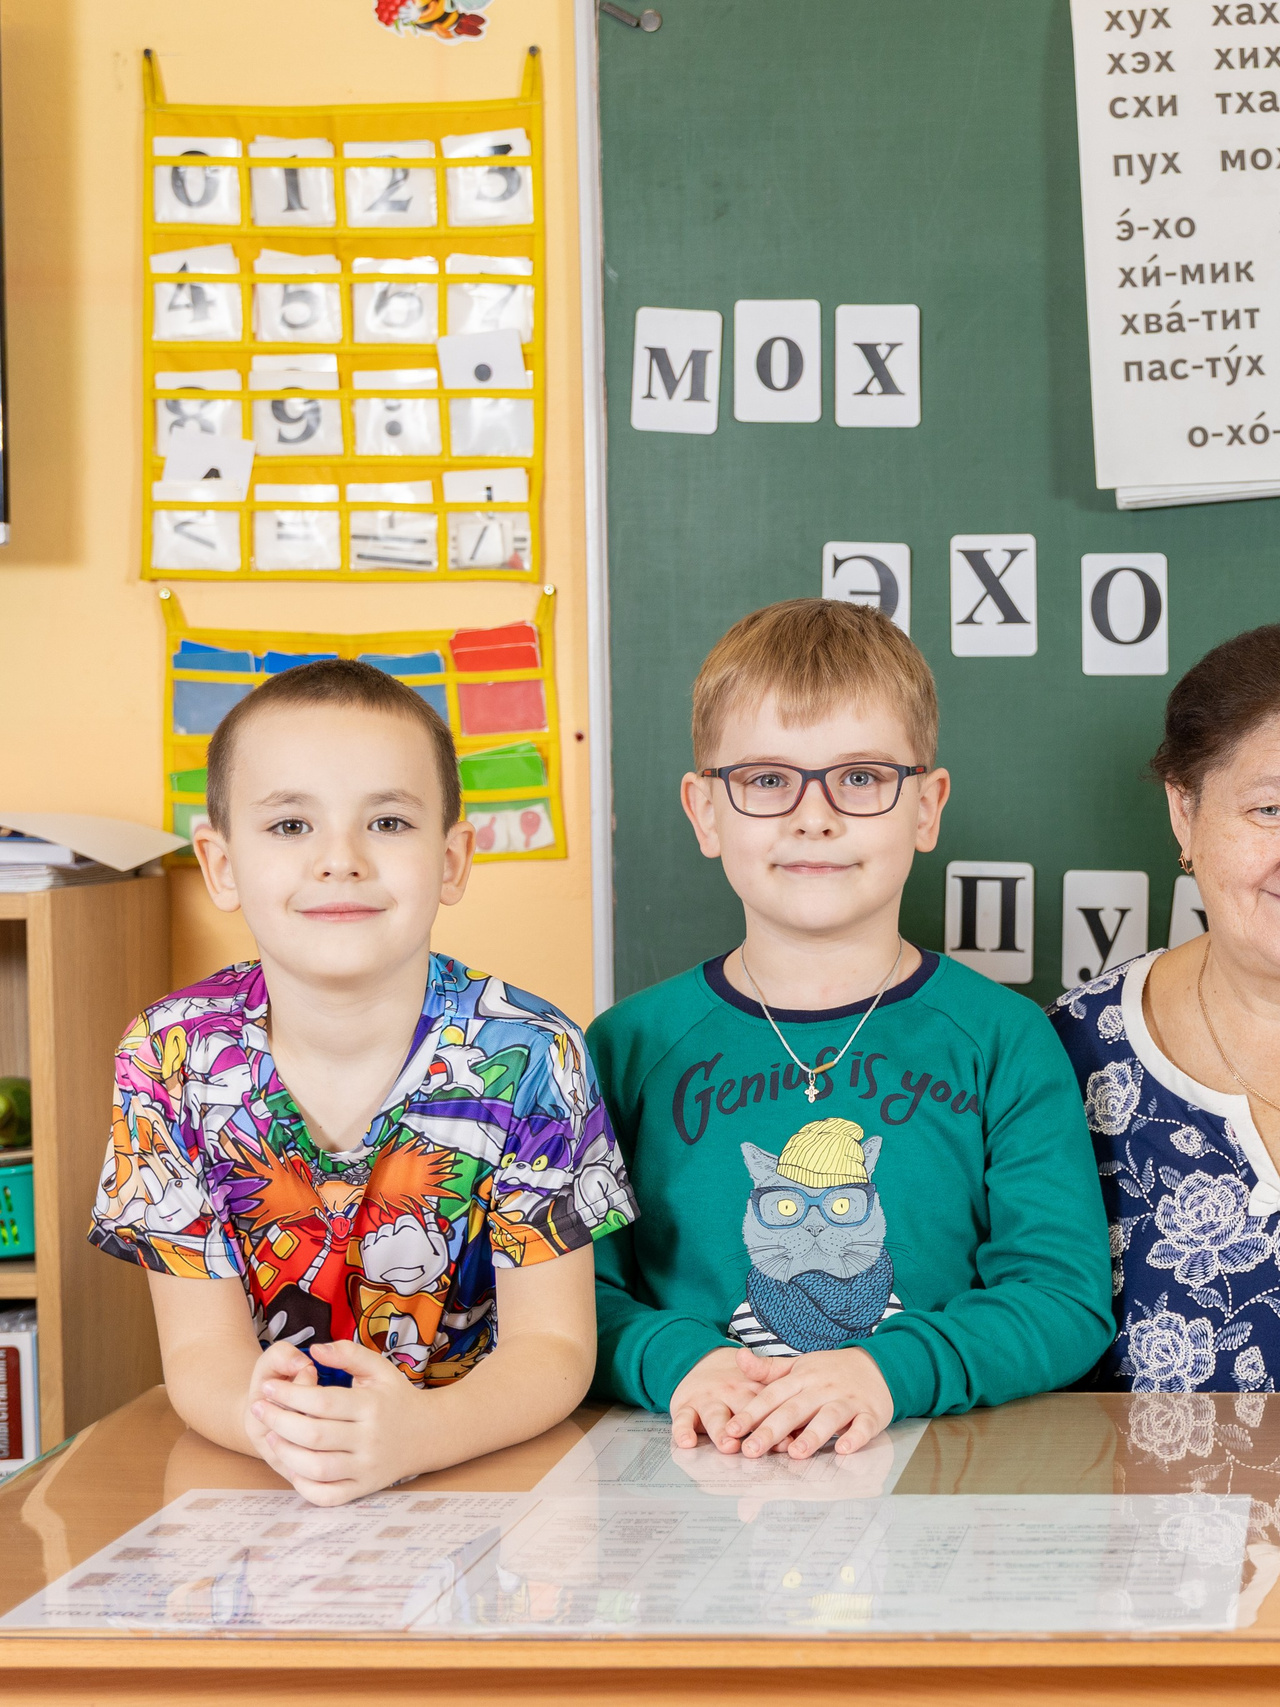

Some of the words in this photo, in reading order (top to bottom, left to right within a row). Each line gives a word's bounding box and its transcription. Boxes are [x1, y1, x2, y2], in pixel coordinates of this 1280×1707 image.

[1106, 8, 1170, 38] хух
[1213, 3, 1279, 25] хах
[1108, 51, 1174, 74] хэх
[1110, 95, 1177, 118] схи
[1216, 91, 1279, 114] тха
[171, 150, 220, 208] 0
[281, 155, 309, 212] 1
[364, 154, 414, 213] 2
[1114, 153, 1181, 184] пух
[672, 1046, 840, 1145] Genius
[849, 1051, 888, 1100] is
[880, 1070, 983, 1126] you
